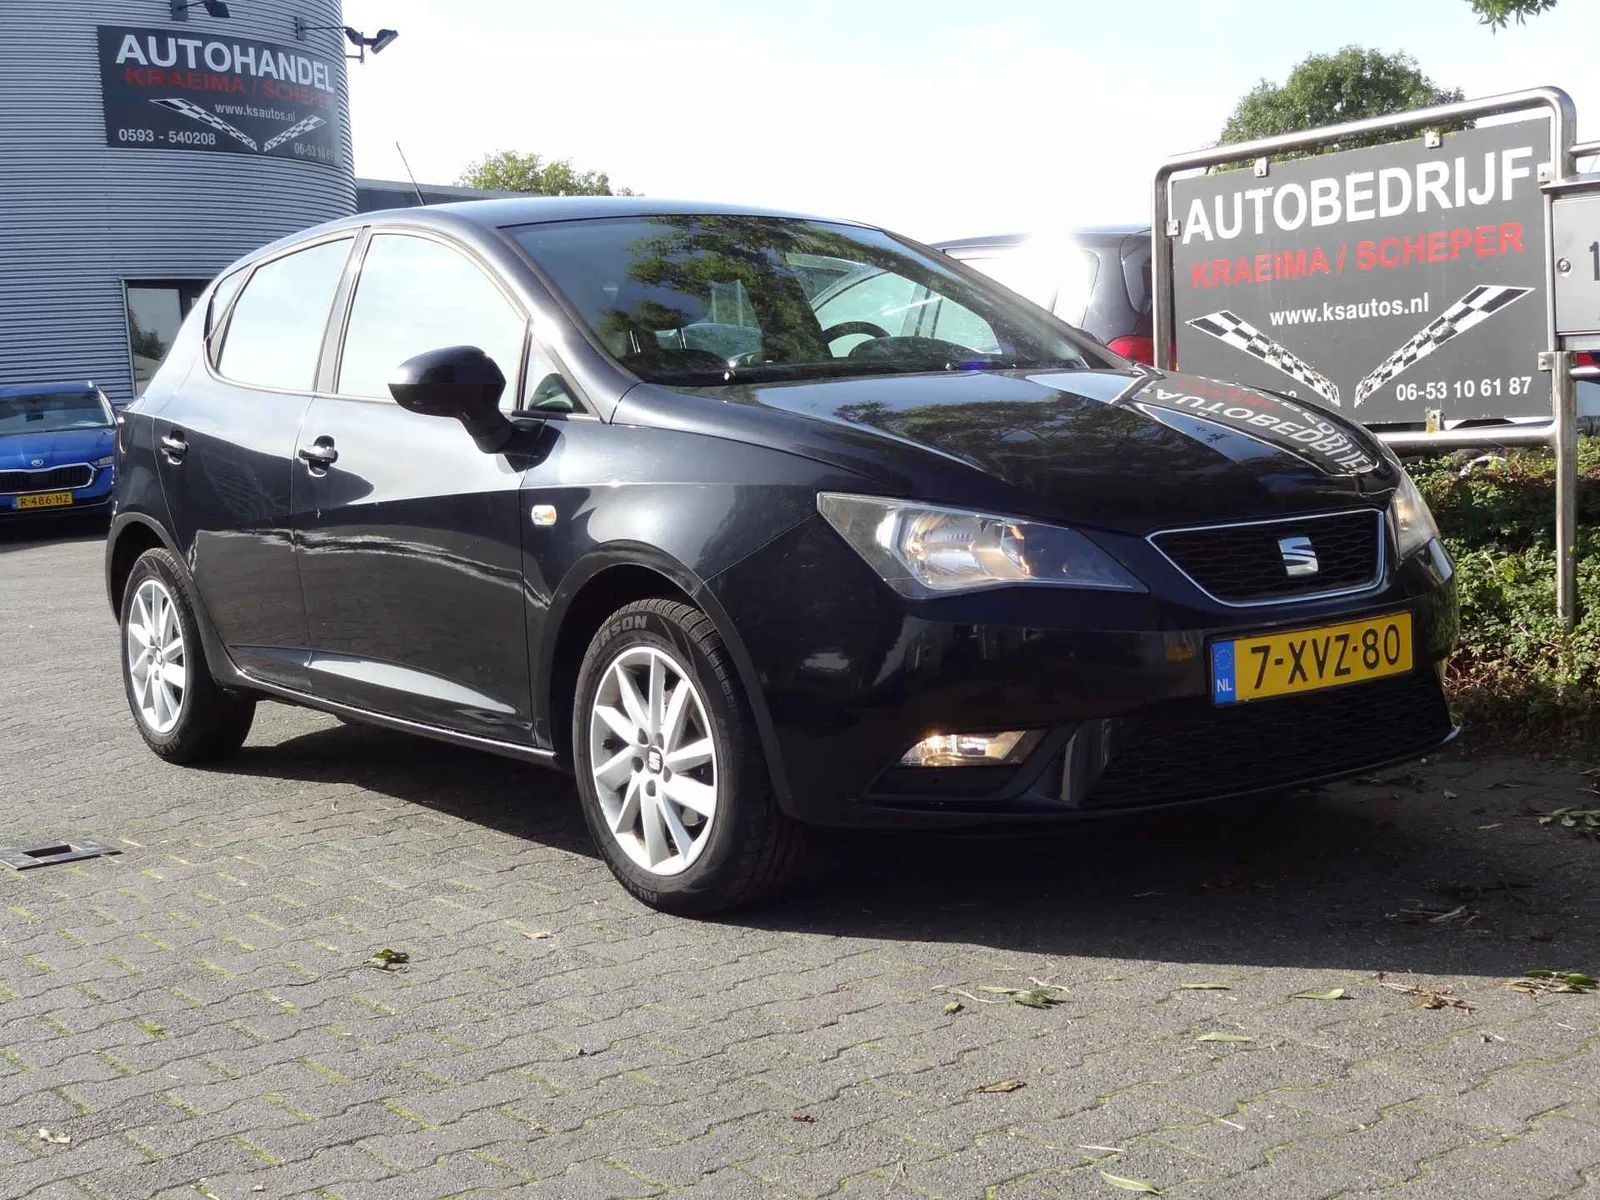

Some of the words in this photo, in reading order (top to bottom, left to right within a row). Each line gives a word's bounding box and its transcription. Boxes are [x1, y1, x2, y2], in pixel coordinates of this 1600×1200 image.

[115, 34, 335, 93] AUTOHANDEL
[125, 67, 245, 93] KRAEIMA
[214, 102, 296, 122] www.ksautos.nl
[118, 128, 154, 143] 0593
[168, 131, 216, 146] 540208
[1182, 146, 1533, 245] AUTOBEDRIJF
[1190, 246, 1331, 290] KRAEIMA
[1355, 222, 1525, 271] SCHEPER
[1270, 292, 1430, 327] www.ksautos.nl
[1396, 381, 1447, 401] 06-53
[1453, 380, 1475, 398] 10
[1480, 378, 1501, 397] 61
[1509, 376, 1532, 395] 87
[1216, 681, 1233, 693] NL
[1250, 624, 1400, 690] 7-XVZ-80
